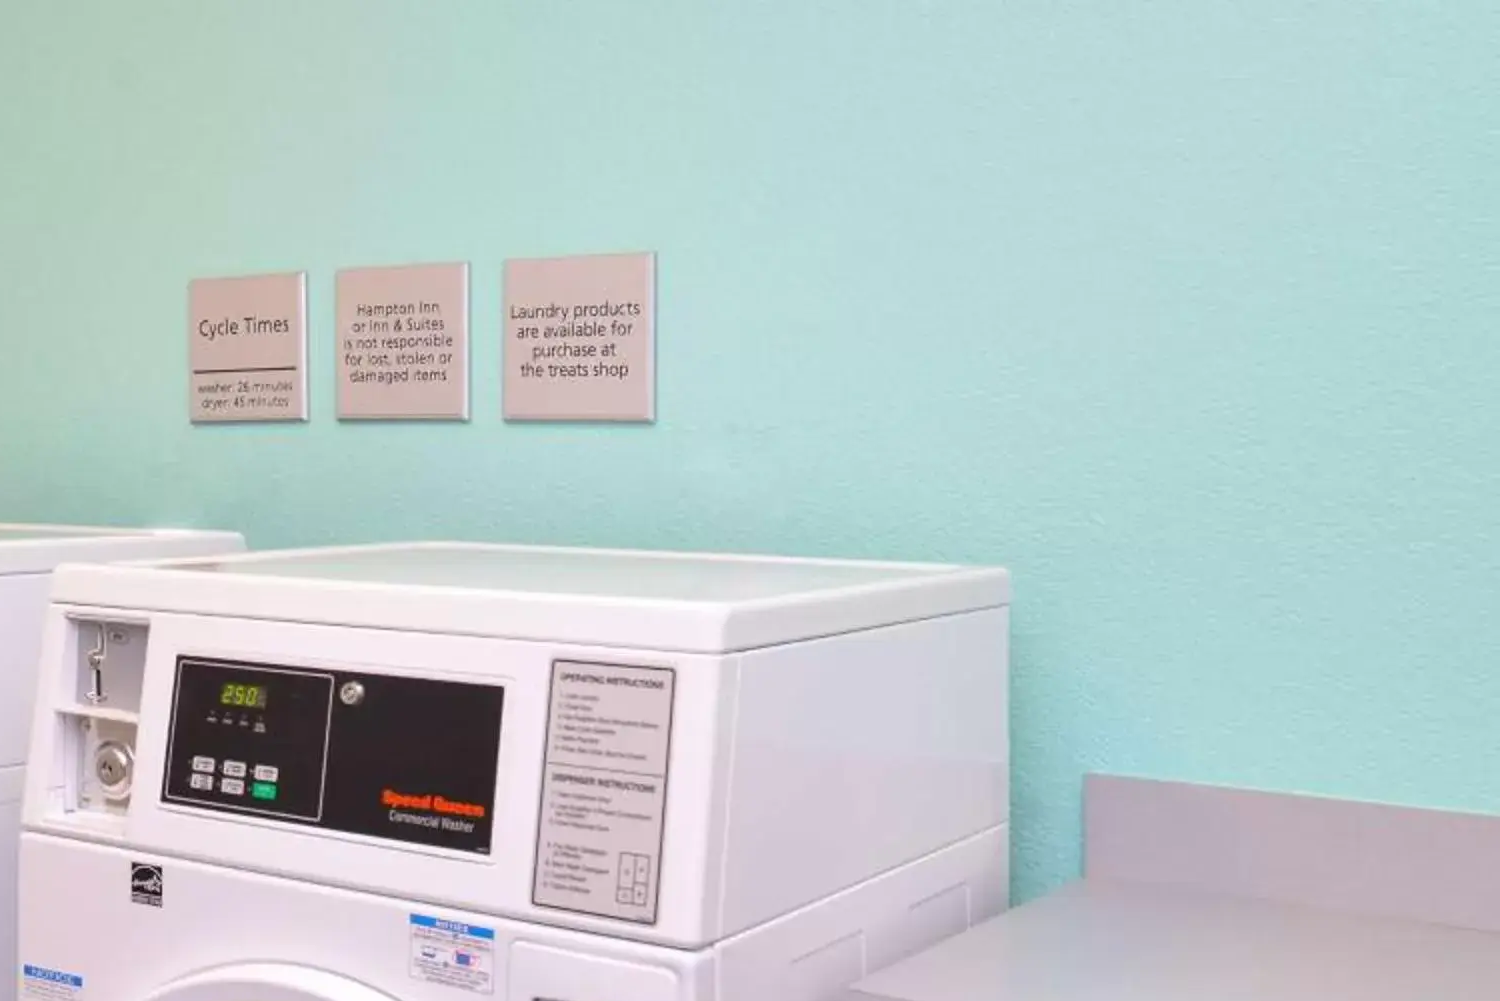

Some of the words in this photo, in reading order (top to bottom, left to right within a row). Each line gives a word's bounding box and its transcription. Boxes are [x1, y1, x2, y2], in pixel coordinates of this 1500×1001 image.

[356, 302, 415, 317] Hampton
[418, 301, 441, 315] Inn
[510, 303, 569, 321] Laundry
[573, 301, 641, 320] products
[199, 317, 239, 342] Cycle
[243, 315, 290, 334] Times
[352, 322, 367, 333] or
[368, 319, 389, 333] Inn
[393, 319, 403, 332] &
[405, 317, 445, 332] Suites
[516, 326, 539, 339] are
[543, 321, 607, 338] available
[610, 319, 633, 337] for
[343, 339, 353, 350] is
[356, 338, 378, 350] not
[381, 334, 453, 350] responsible
[345, 353, 363, 367] for
[395, 351, 435, 365] stolen
[438, 353, 453, 365] or
[531, 342, 597, 360] purchase
[600, 343, 618, 357] at
[349, 368, 409, 384] damaged
[413, 369, 448, 381] items
[519, 362, 545, 378] the
[547, 363, 589, 378] treats
[592, 361, 629, 380] shop
[252, 380, 293, 393] minutes
[249, 395, 290, 409] minutes
[382, 788, 431, 808] Speed
[433, 794, 485, 817] Queen
[388, 809, 439, 829] Commercial
[441, 816, 475, 833] Washer
